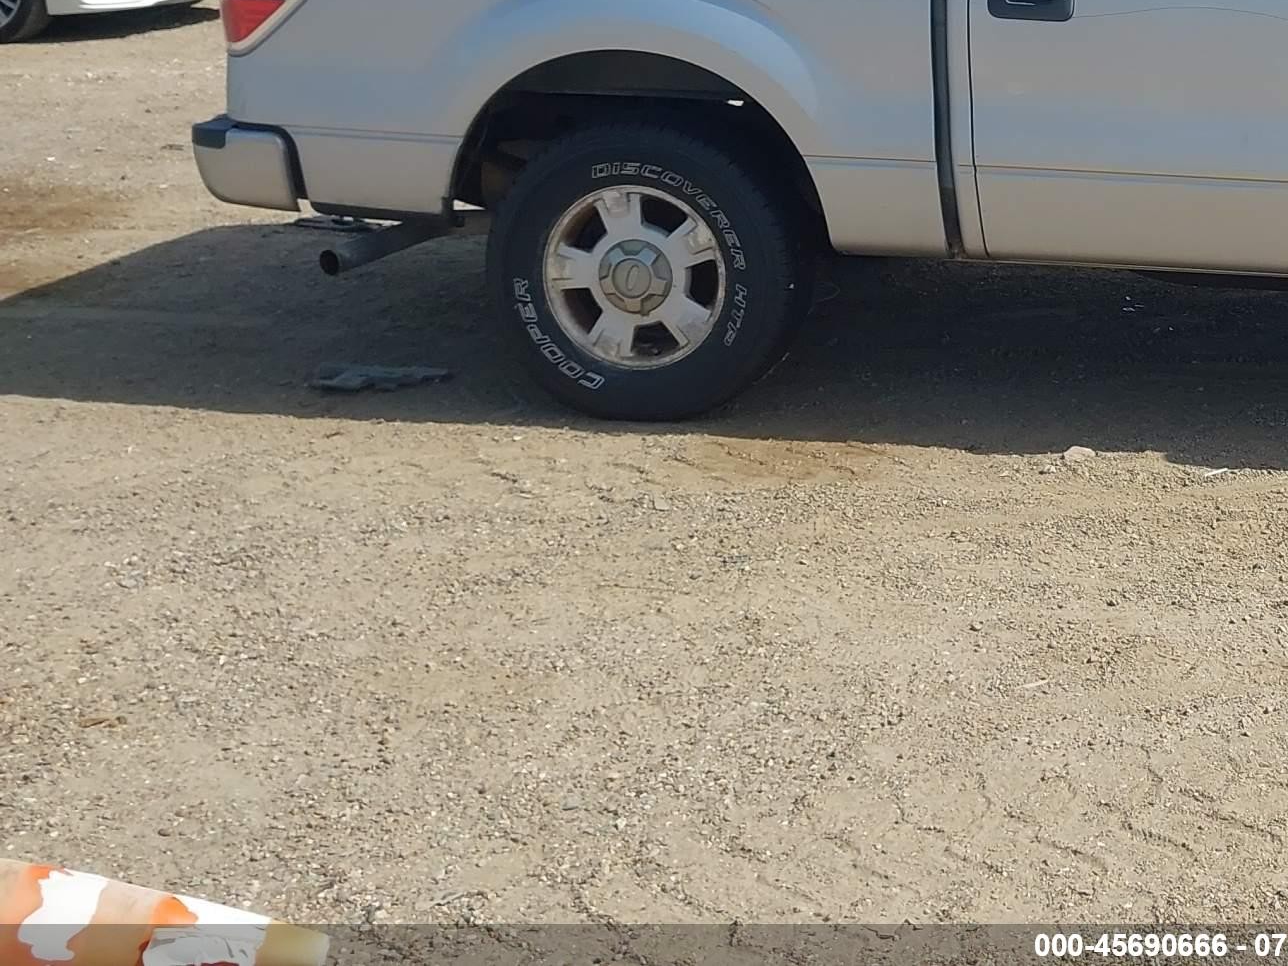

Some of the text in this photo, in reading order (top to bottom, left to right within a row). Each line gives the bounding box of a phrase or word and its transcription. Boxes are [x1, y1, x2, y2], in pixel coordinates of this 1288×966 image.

[591, 162, 748, 347] DISCOVERER HTP
[512, 277, 606, 390] COOPER
